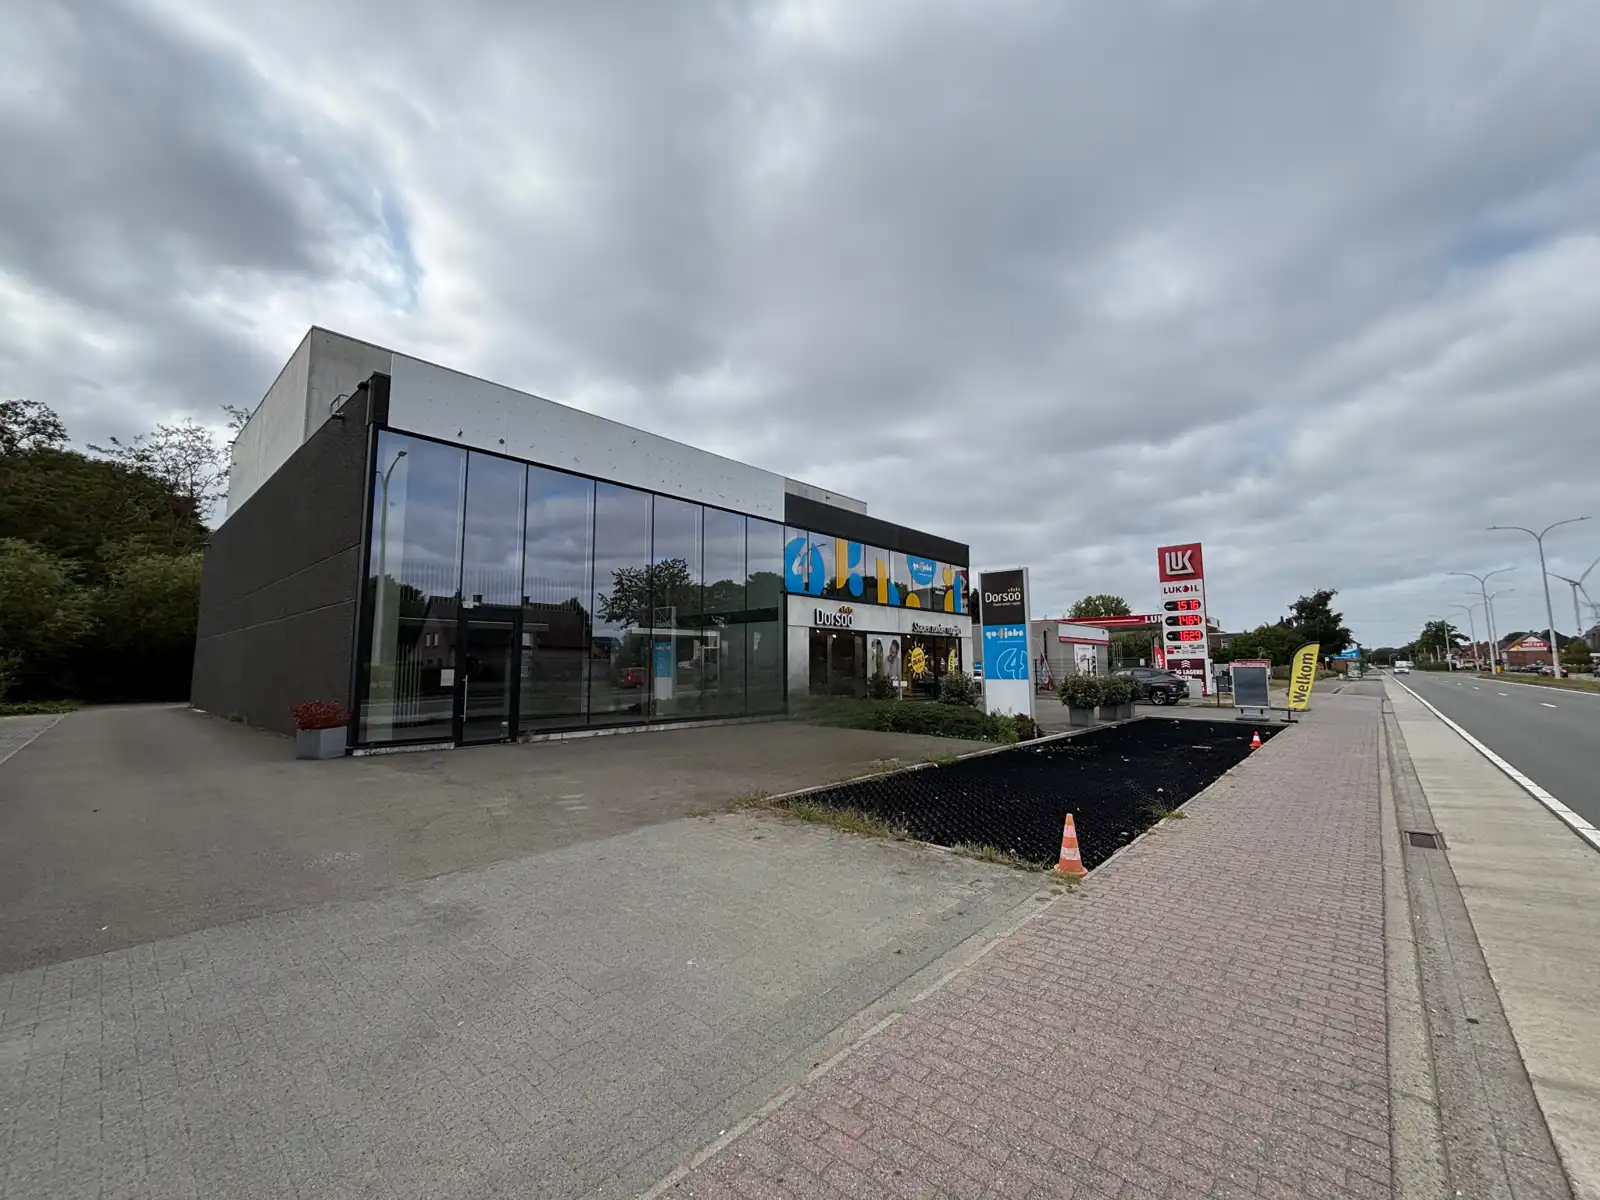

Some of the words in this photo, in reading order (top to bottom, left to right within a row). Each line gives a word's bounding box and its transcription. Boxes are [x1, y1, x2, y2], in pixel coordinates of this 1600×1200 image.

[1165, 549, 1195, 575] LUK
[985, 591, 1021, 603] Dorsoo
[1163, 584, 1200, 594] LUKOIL
[814, 607, 854, 626] Dorsoo
[985, 627, 1024, 640] go4jobs
[1292, 652, 1314, 704] Welkom
